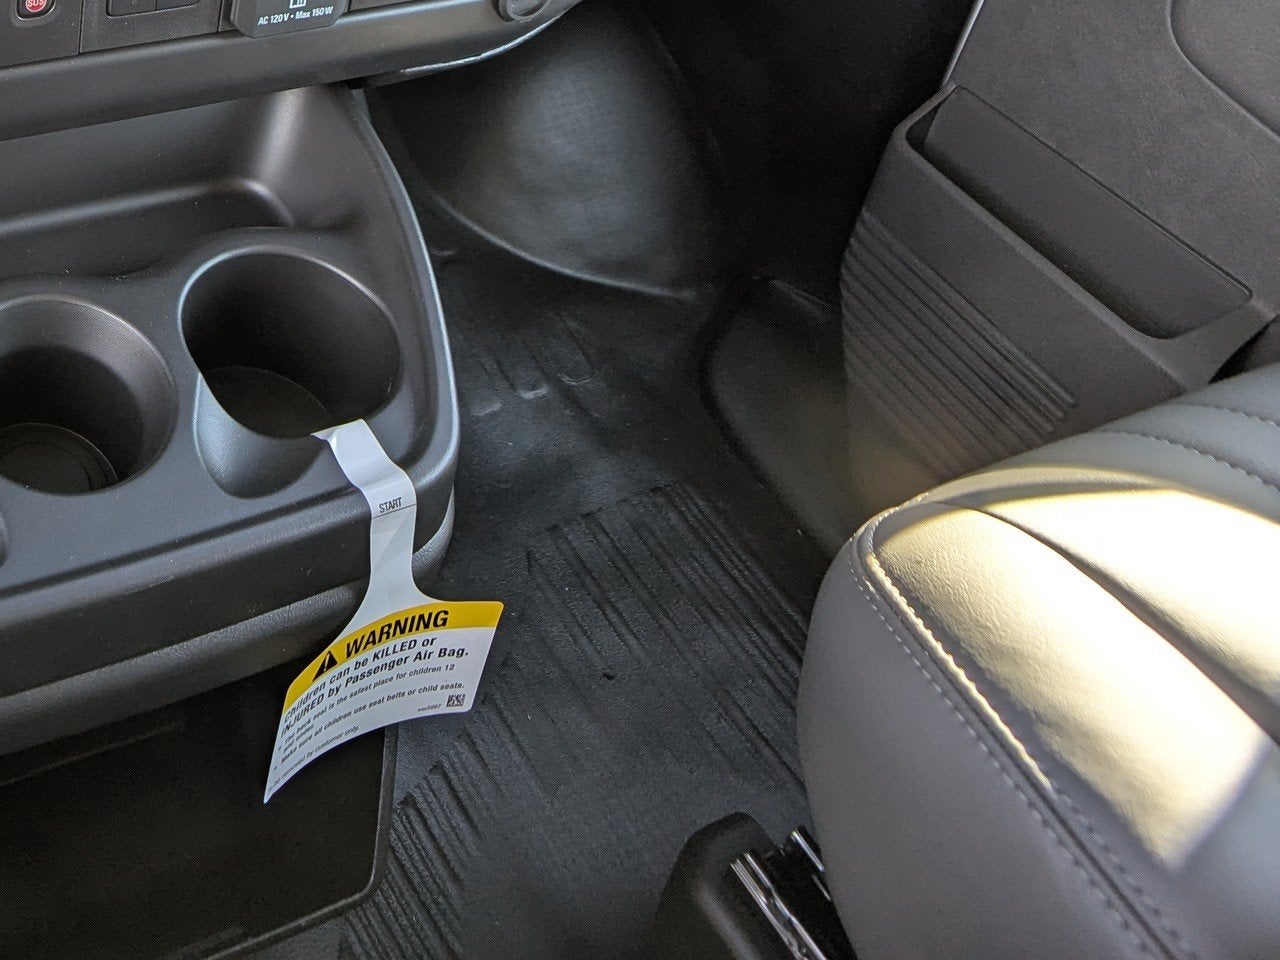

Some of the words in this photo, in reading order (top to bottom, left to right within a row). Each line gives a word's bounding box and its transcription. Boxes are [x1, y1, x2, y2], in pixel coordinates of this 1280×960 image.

[258, 16, 269, 25] AC
[295, 11, 311, 20] Max
[379, 496, 402, 513] START
[346, 610, 450, 659] WARNING
[280, 693, 325, 738] INJURED
[327, 683, 342, 700] by
[345, 655, 410, 688] Passenger
[413, 650, 434, 663] Air
[437, 647, 469, 659] Bag.
[284, 681, 326, 723] Children
[329, 666, 351, 685] can
[354, 658, 369, 671] be
[372, 639, 417, 662] KILLED
[421, 637, 437, 648] or
[336, 695, 348, 706] the
[349, 683, 372, 698] safest
[372, 673, 393, 689] place
[395, 672, 407, 681] for
[408, 666, 441, 677] children
[445, 663, 456, 672] 12
[323, 711, 352, 730] children
[353, 704, 367, 715] use
[368, 697, 385, 709] seat
[385, 691, 406, 702] belts
[417, 683, 438, 694] child
[440, 682, 464, 690] seats.
